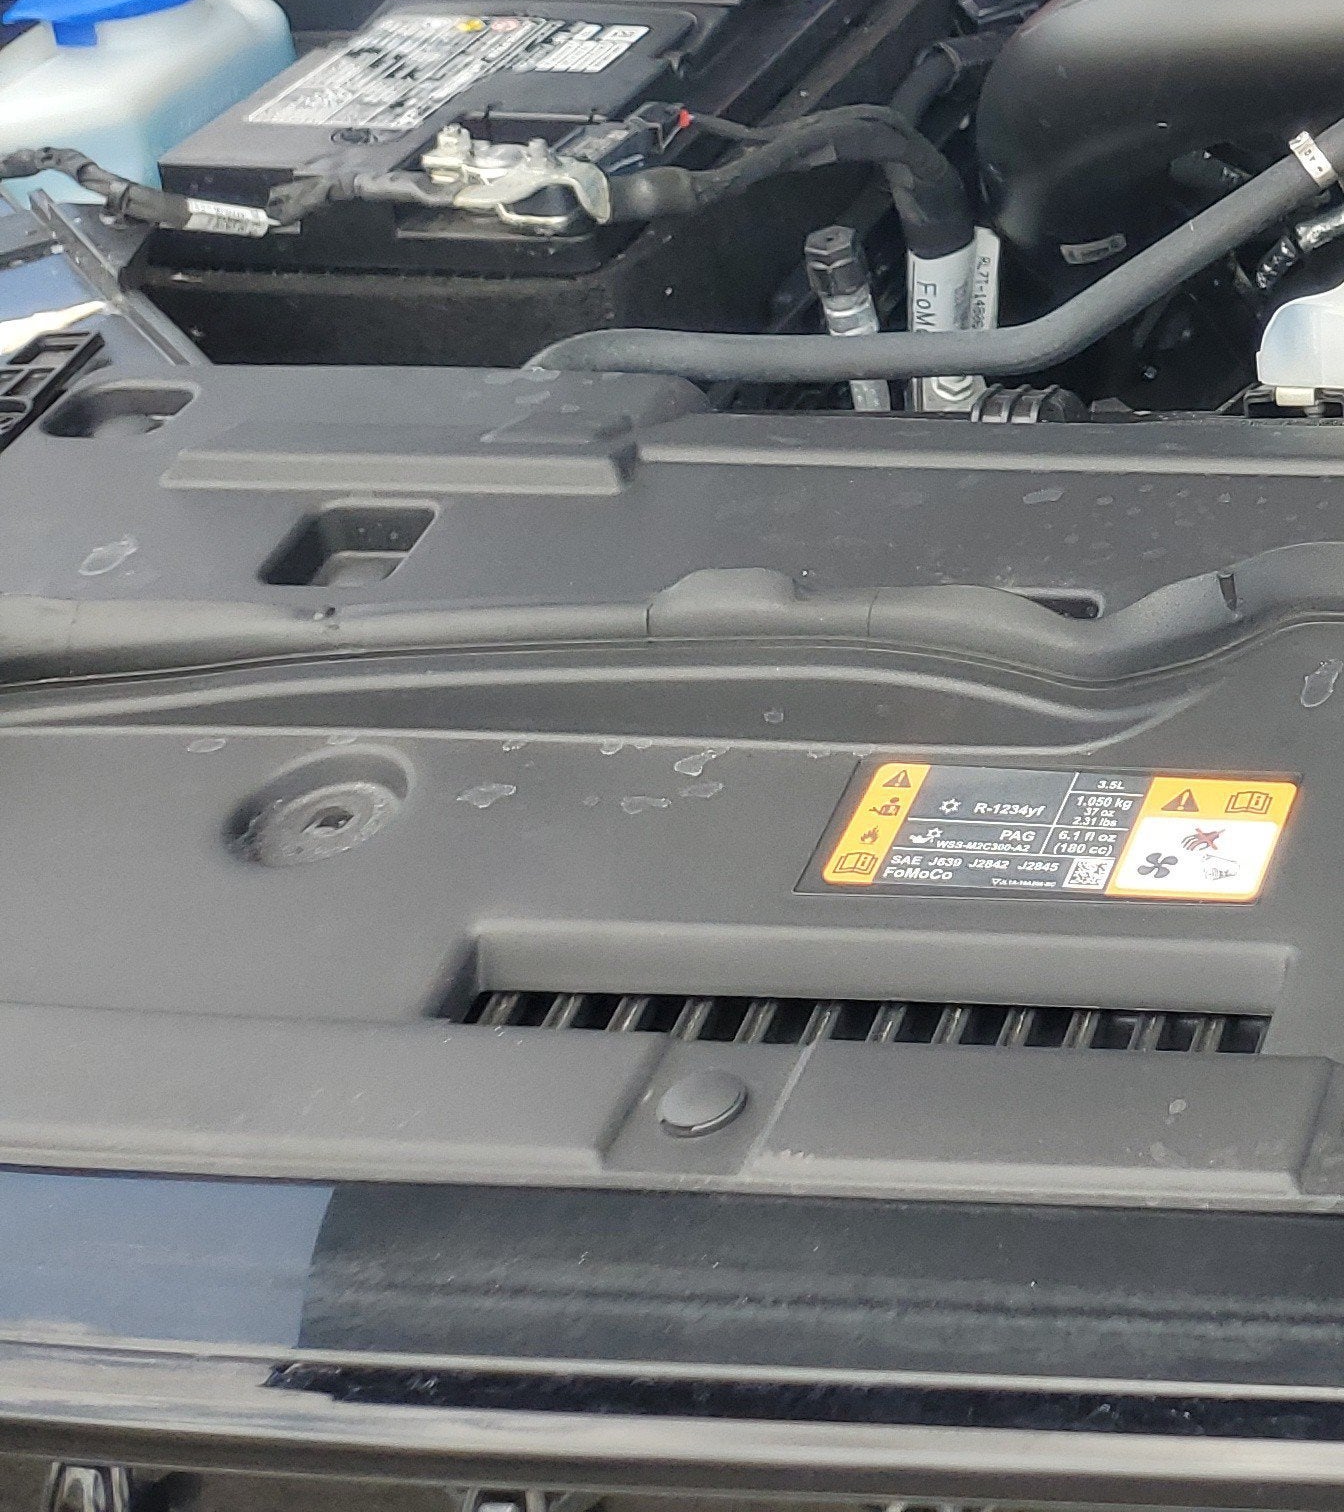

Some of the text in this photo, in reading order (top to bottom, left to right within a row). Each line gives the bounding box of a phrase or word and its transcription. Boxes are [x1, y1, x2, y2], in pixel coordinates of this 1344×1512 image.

[1097, 780, 1125, 790] 3.5L
[1076, 795, 1133, 811] 1.050 kg
[973, 802, 1046, 818] R-1234yf
[1083, 807, 1116, 817] 37 oz
[1072, 816, 1118, 827] 2.31 lbs
[999, 829, 1037, 842] PAG
[1058, 830, 1118, 843] 6.1 fl oz
[1053, 842, 1113, 857] (180 cc)
[890, 854, 1060, 872] SAE J639 J2842 J2845
[882, 866, 953, 880] FoMoCo
